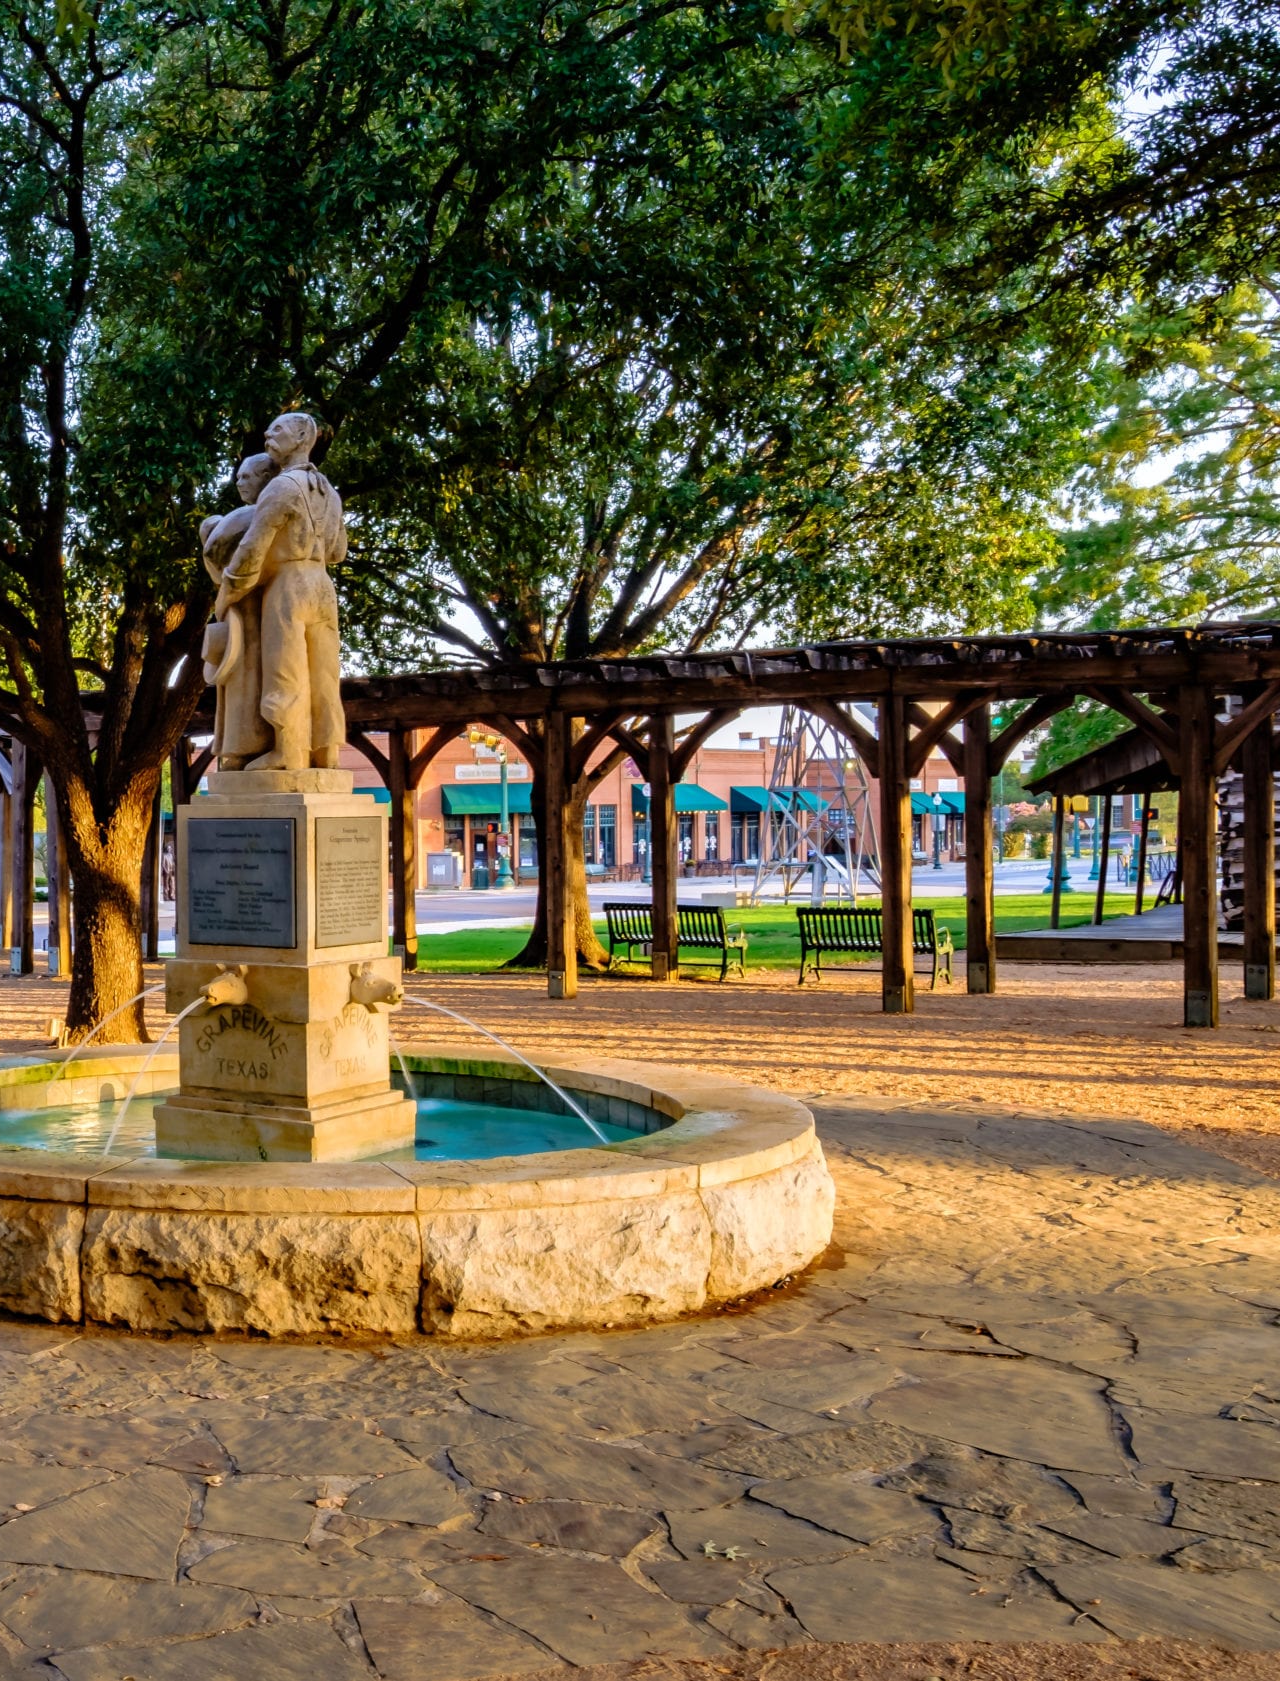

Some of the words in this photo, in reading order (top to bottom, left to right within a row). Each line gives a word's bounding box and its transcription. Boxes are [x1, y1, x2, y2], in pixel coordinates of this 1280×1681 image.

[196, 1007, 288, 1060] GRAPEVINE
[319, 1006, 378, 1058] GRAPEVINE
[215, 1057, 269, 1080] TEXAS
[334, 1056, 366, 1077] TEXAS
